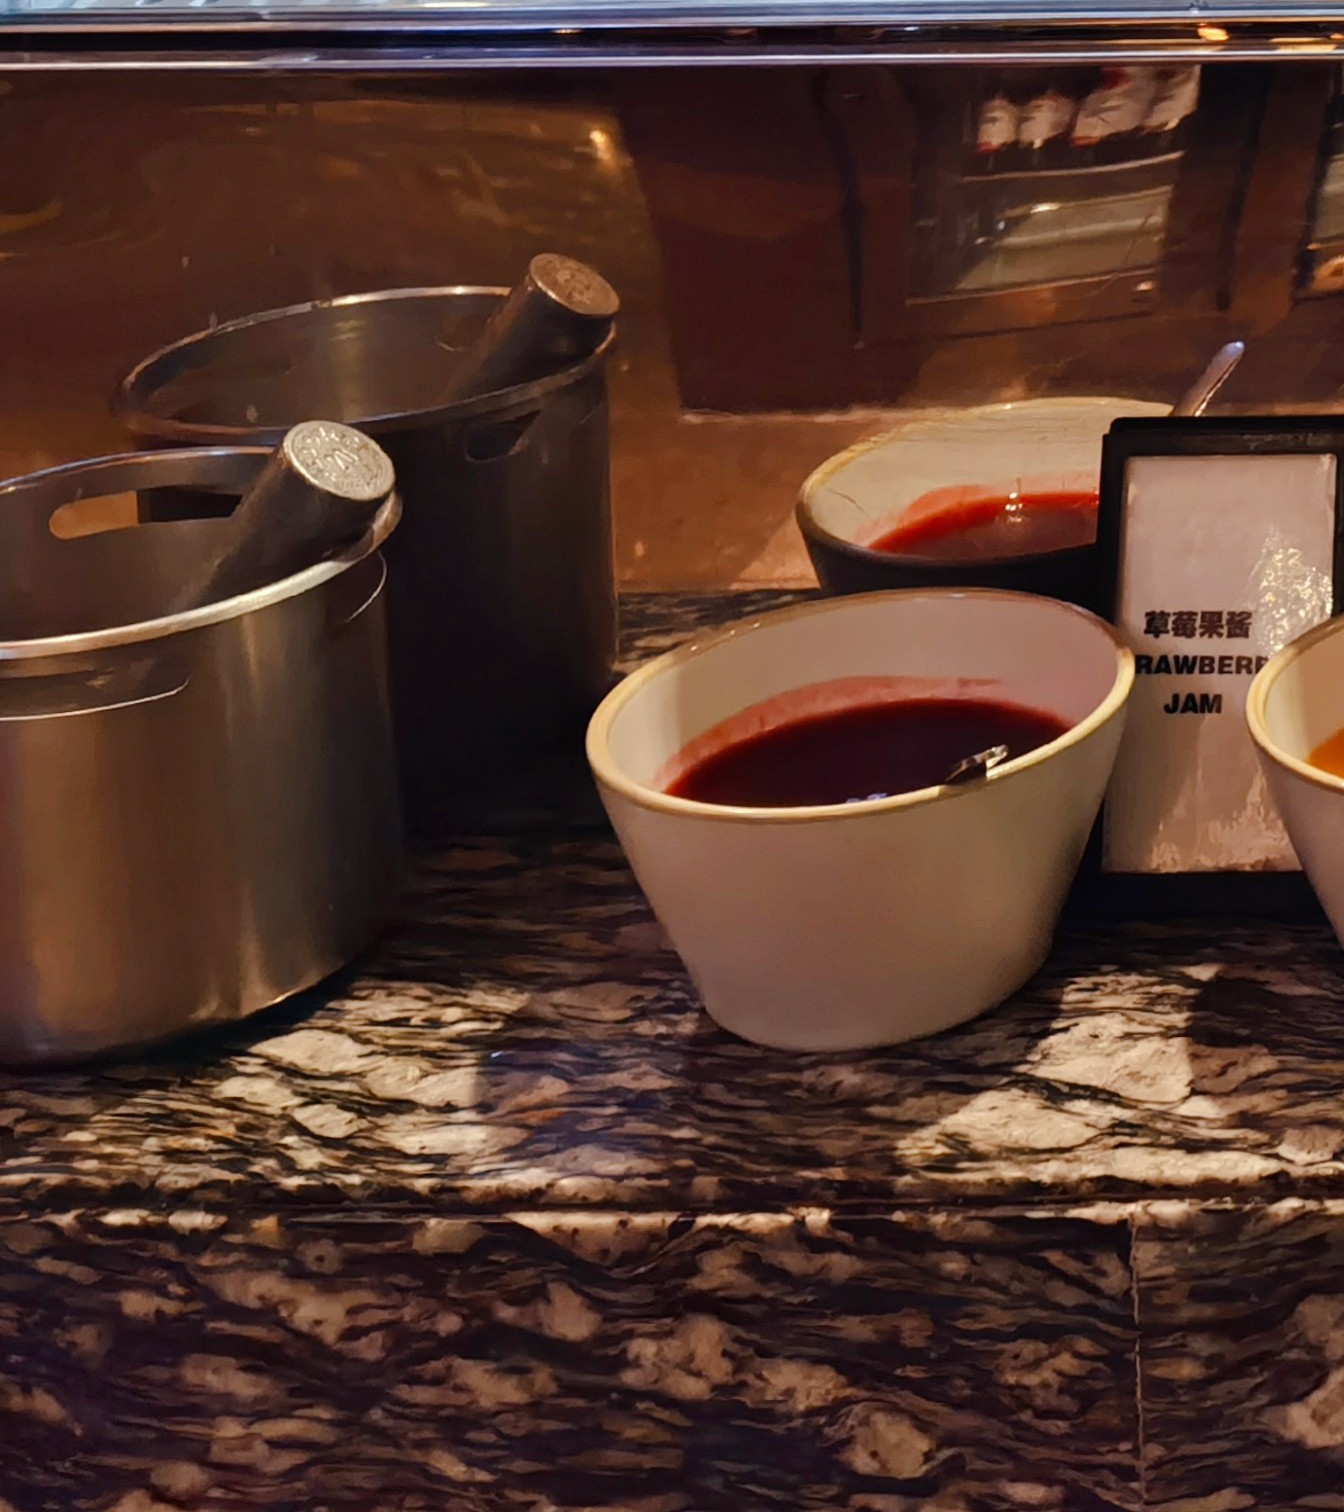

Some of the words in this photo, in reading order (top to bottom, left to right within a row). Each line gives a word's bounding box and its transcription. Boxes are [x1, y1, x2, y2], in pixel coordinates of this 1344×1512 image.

[1144, 610, 1252, 639] 草莓果酱
[1163, 693, 1223, 714] JAM
